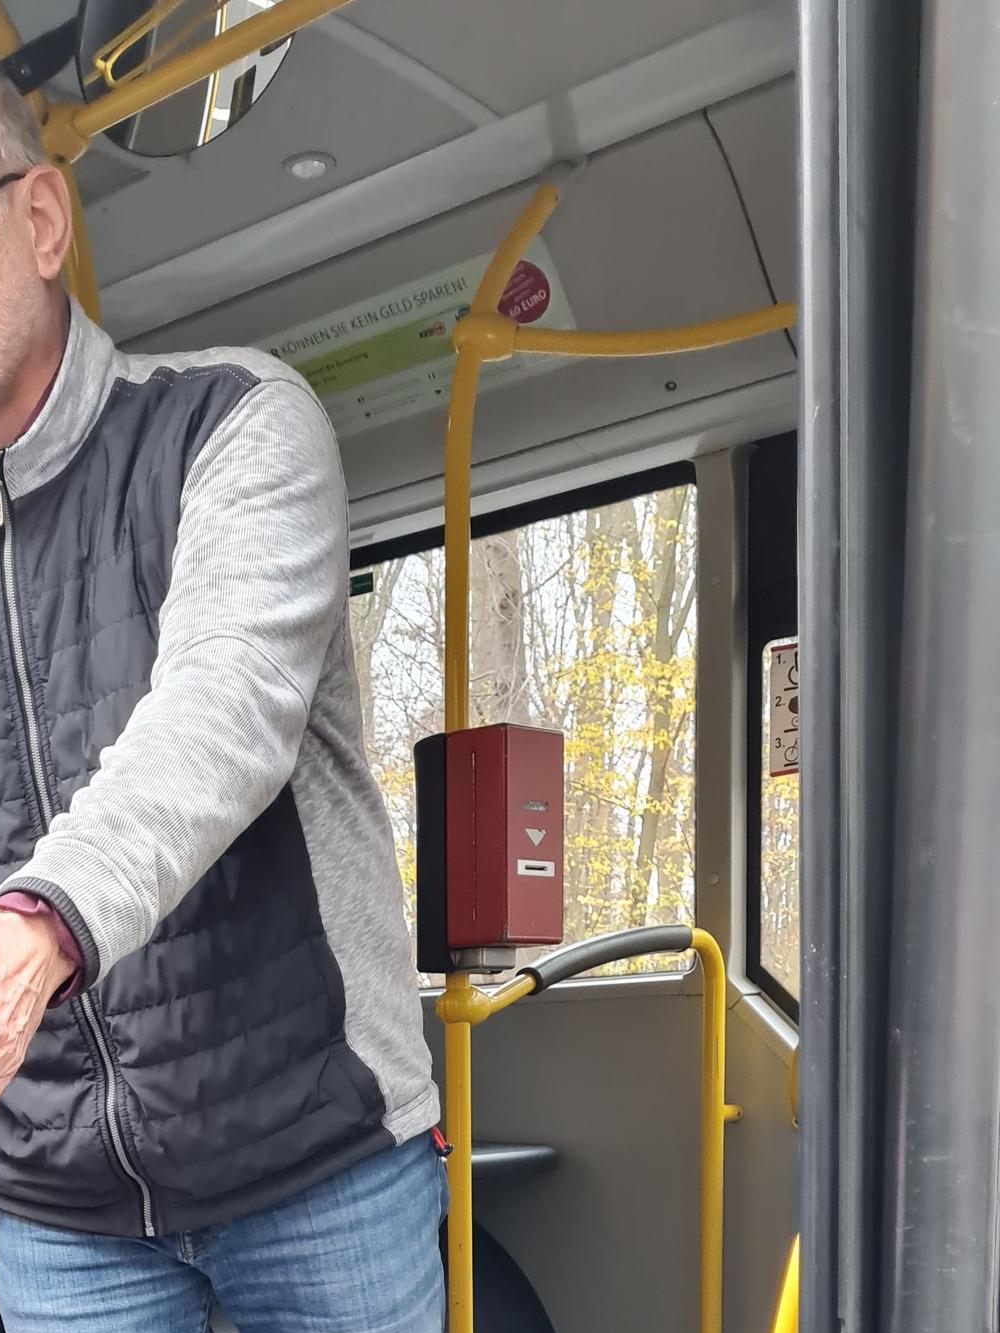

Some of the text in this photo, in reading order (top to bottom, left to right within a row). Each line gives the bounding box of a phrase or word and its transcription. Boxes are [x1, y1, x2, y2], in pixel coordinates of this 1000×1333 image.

[520, 289, 547, 311] EURO
[281, 330, 330, 357] KÖNNEN
[331, 322, 350, 339] SIE
[351, 311, 379, 329] KEIN
[380, 300, 413, 319] GELD
[413, 277, 467, 308] SPAREN!
[776, 654, 786, 665] 1.
[775, 696, 786, 707] 2.
[775, 737, 786, 749] 3.
